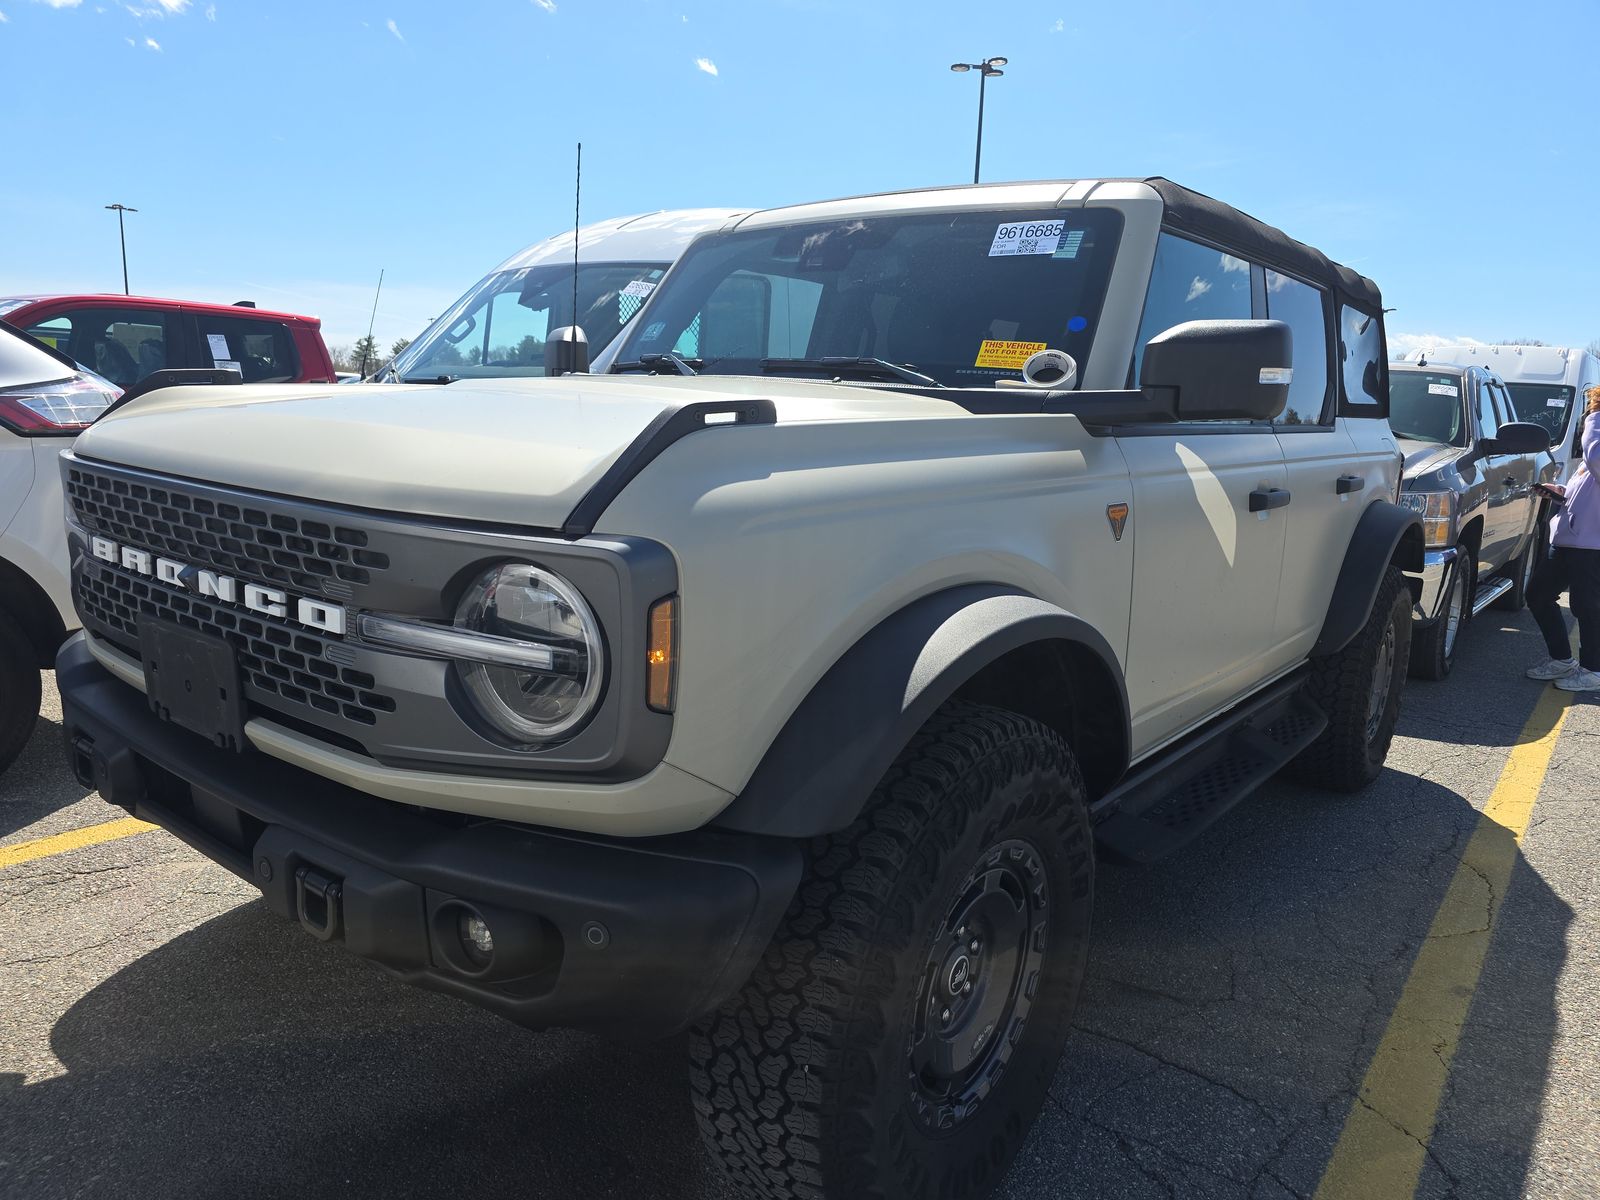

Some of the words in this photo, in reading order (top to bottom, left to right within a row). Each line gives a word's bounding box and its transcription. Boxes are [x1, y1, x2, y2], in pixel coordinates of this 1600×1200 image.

[998, 224, 1064, 240] 9616685
[985, 341, 1004, 349] THIS
[1006, 342, 1044, 351] VEHICLE
[92, 535, 347, 635] BRONCO
